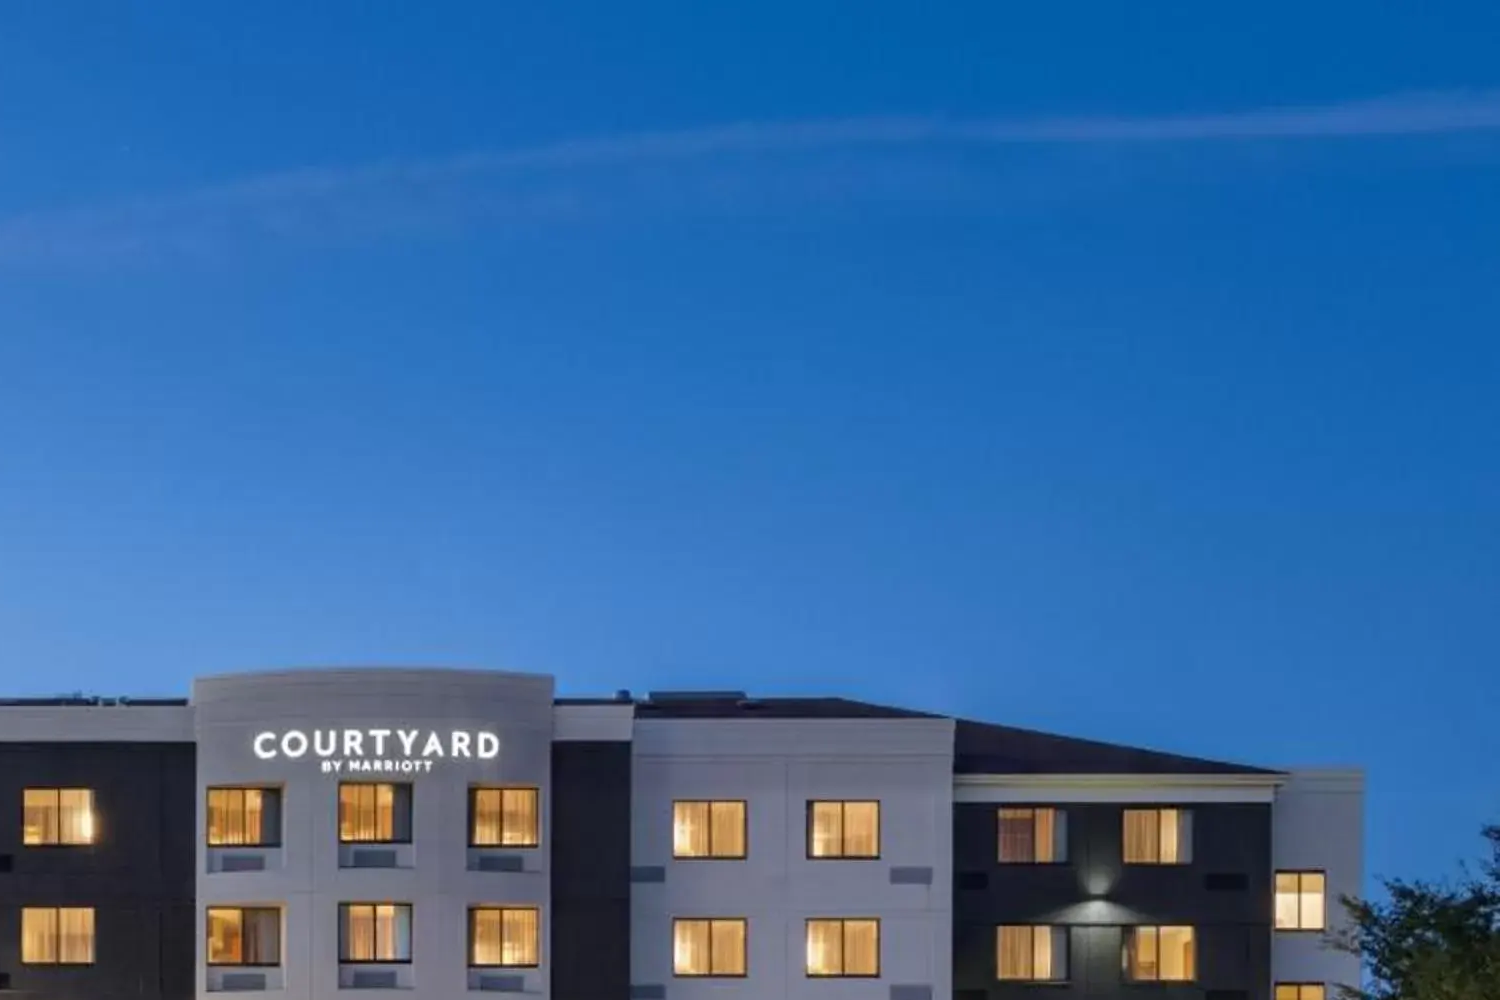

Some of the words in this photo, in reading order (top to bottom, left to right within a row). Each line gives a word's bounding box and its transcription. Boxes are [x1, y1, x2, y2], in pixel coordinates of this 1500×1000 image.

[253, 730, 500, 759] COURTYARD
[321, 760, 341, 772] BY
[349, 760, 433, 773] MARRIOTT
